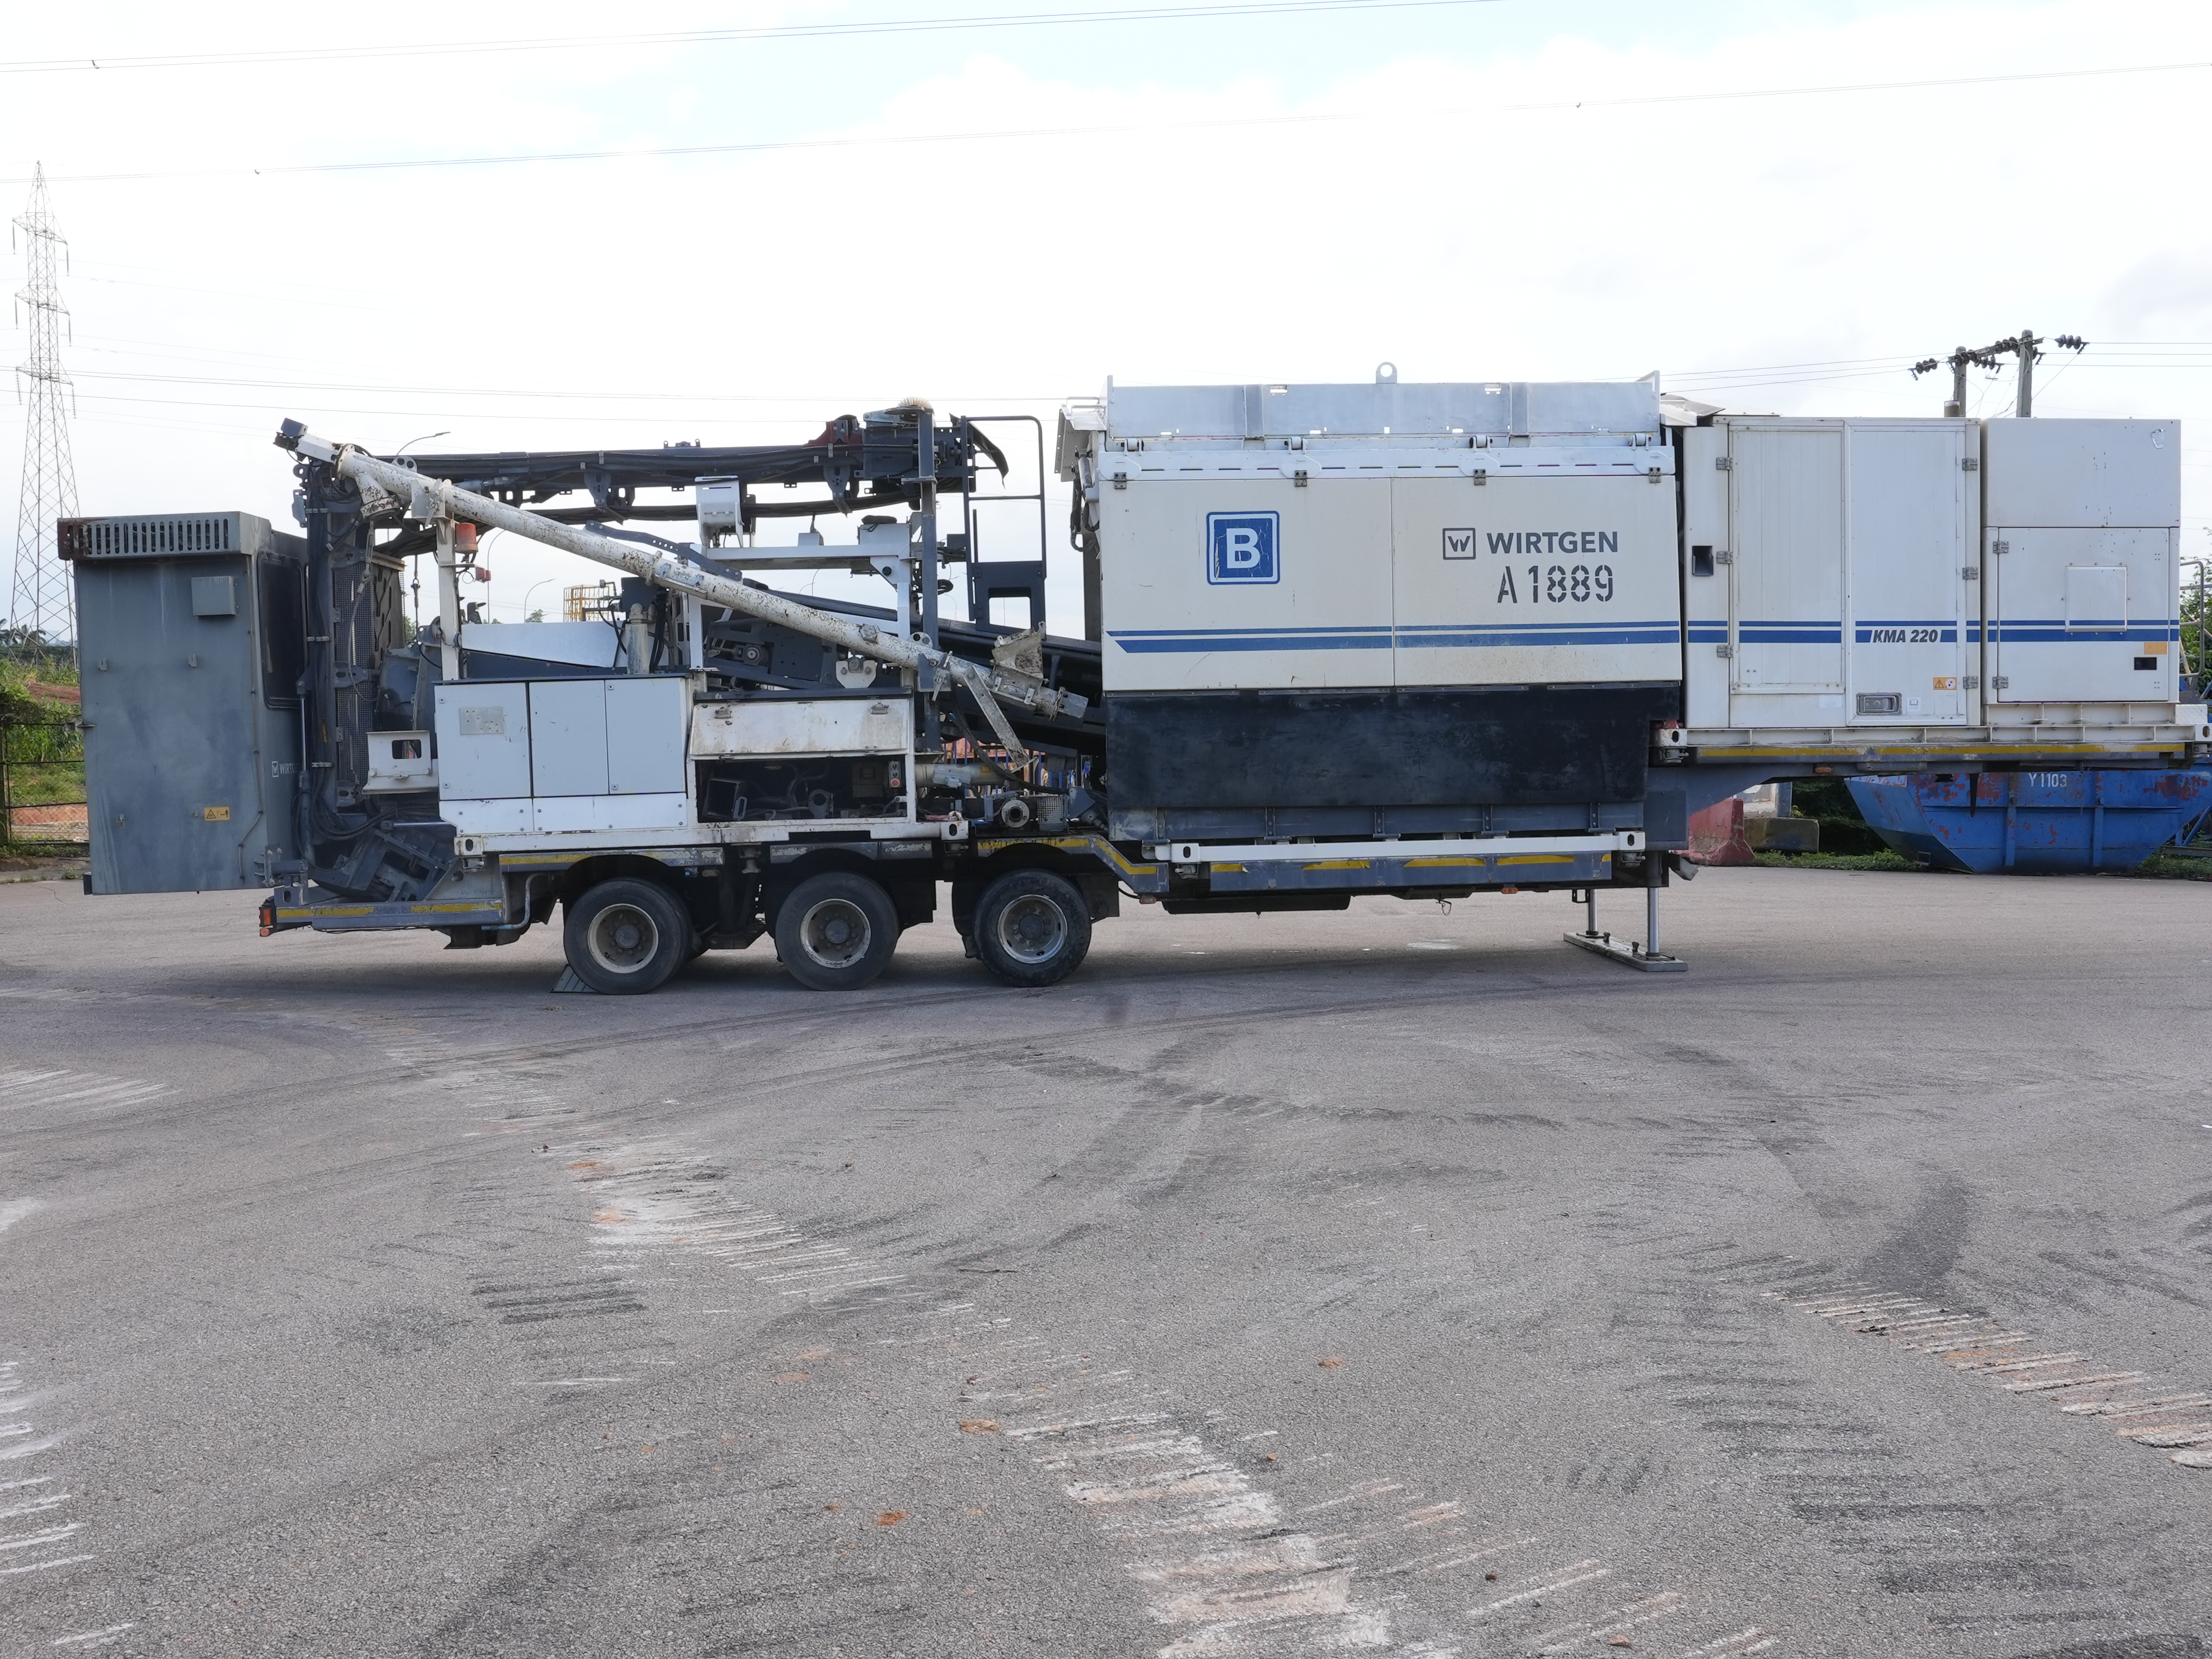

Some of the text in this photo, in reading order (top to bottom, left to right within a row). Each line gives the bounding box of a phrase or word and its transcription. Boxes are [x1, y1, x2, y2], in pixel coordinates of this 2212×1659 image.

[1226, 528, 1261, 569] B
[1486, 531, 1618, 554] WIRTGEN
[1872, 629, 1938, 643] KMA 220
